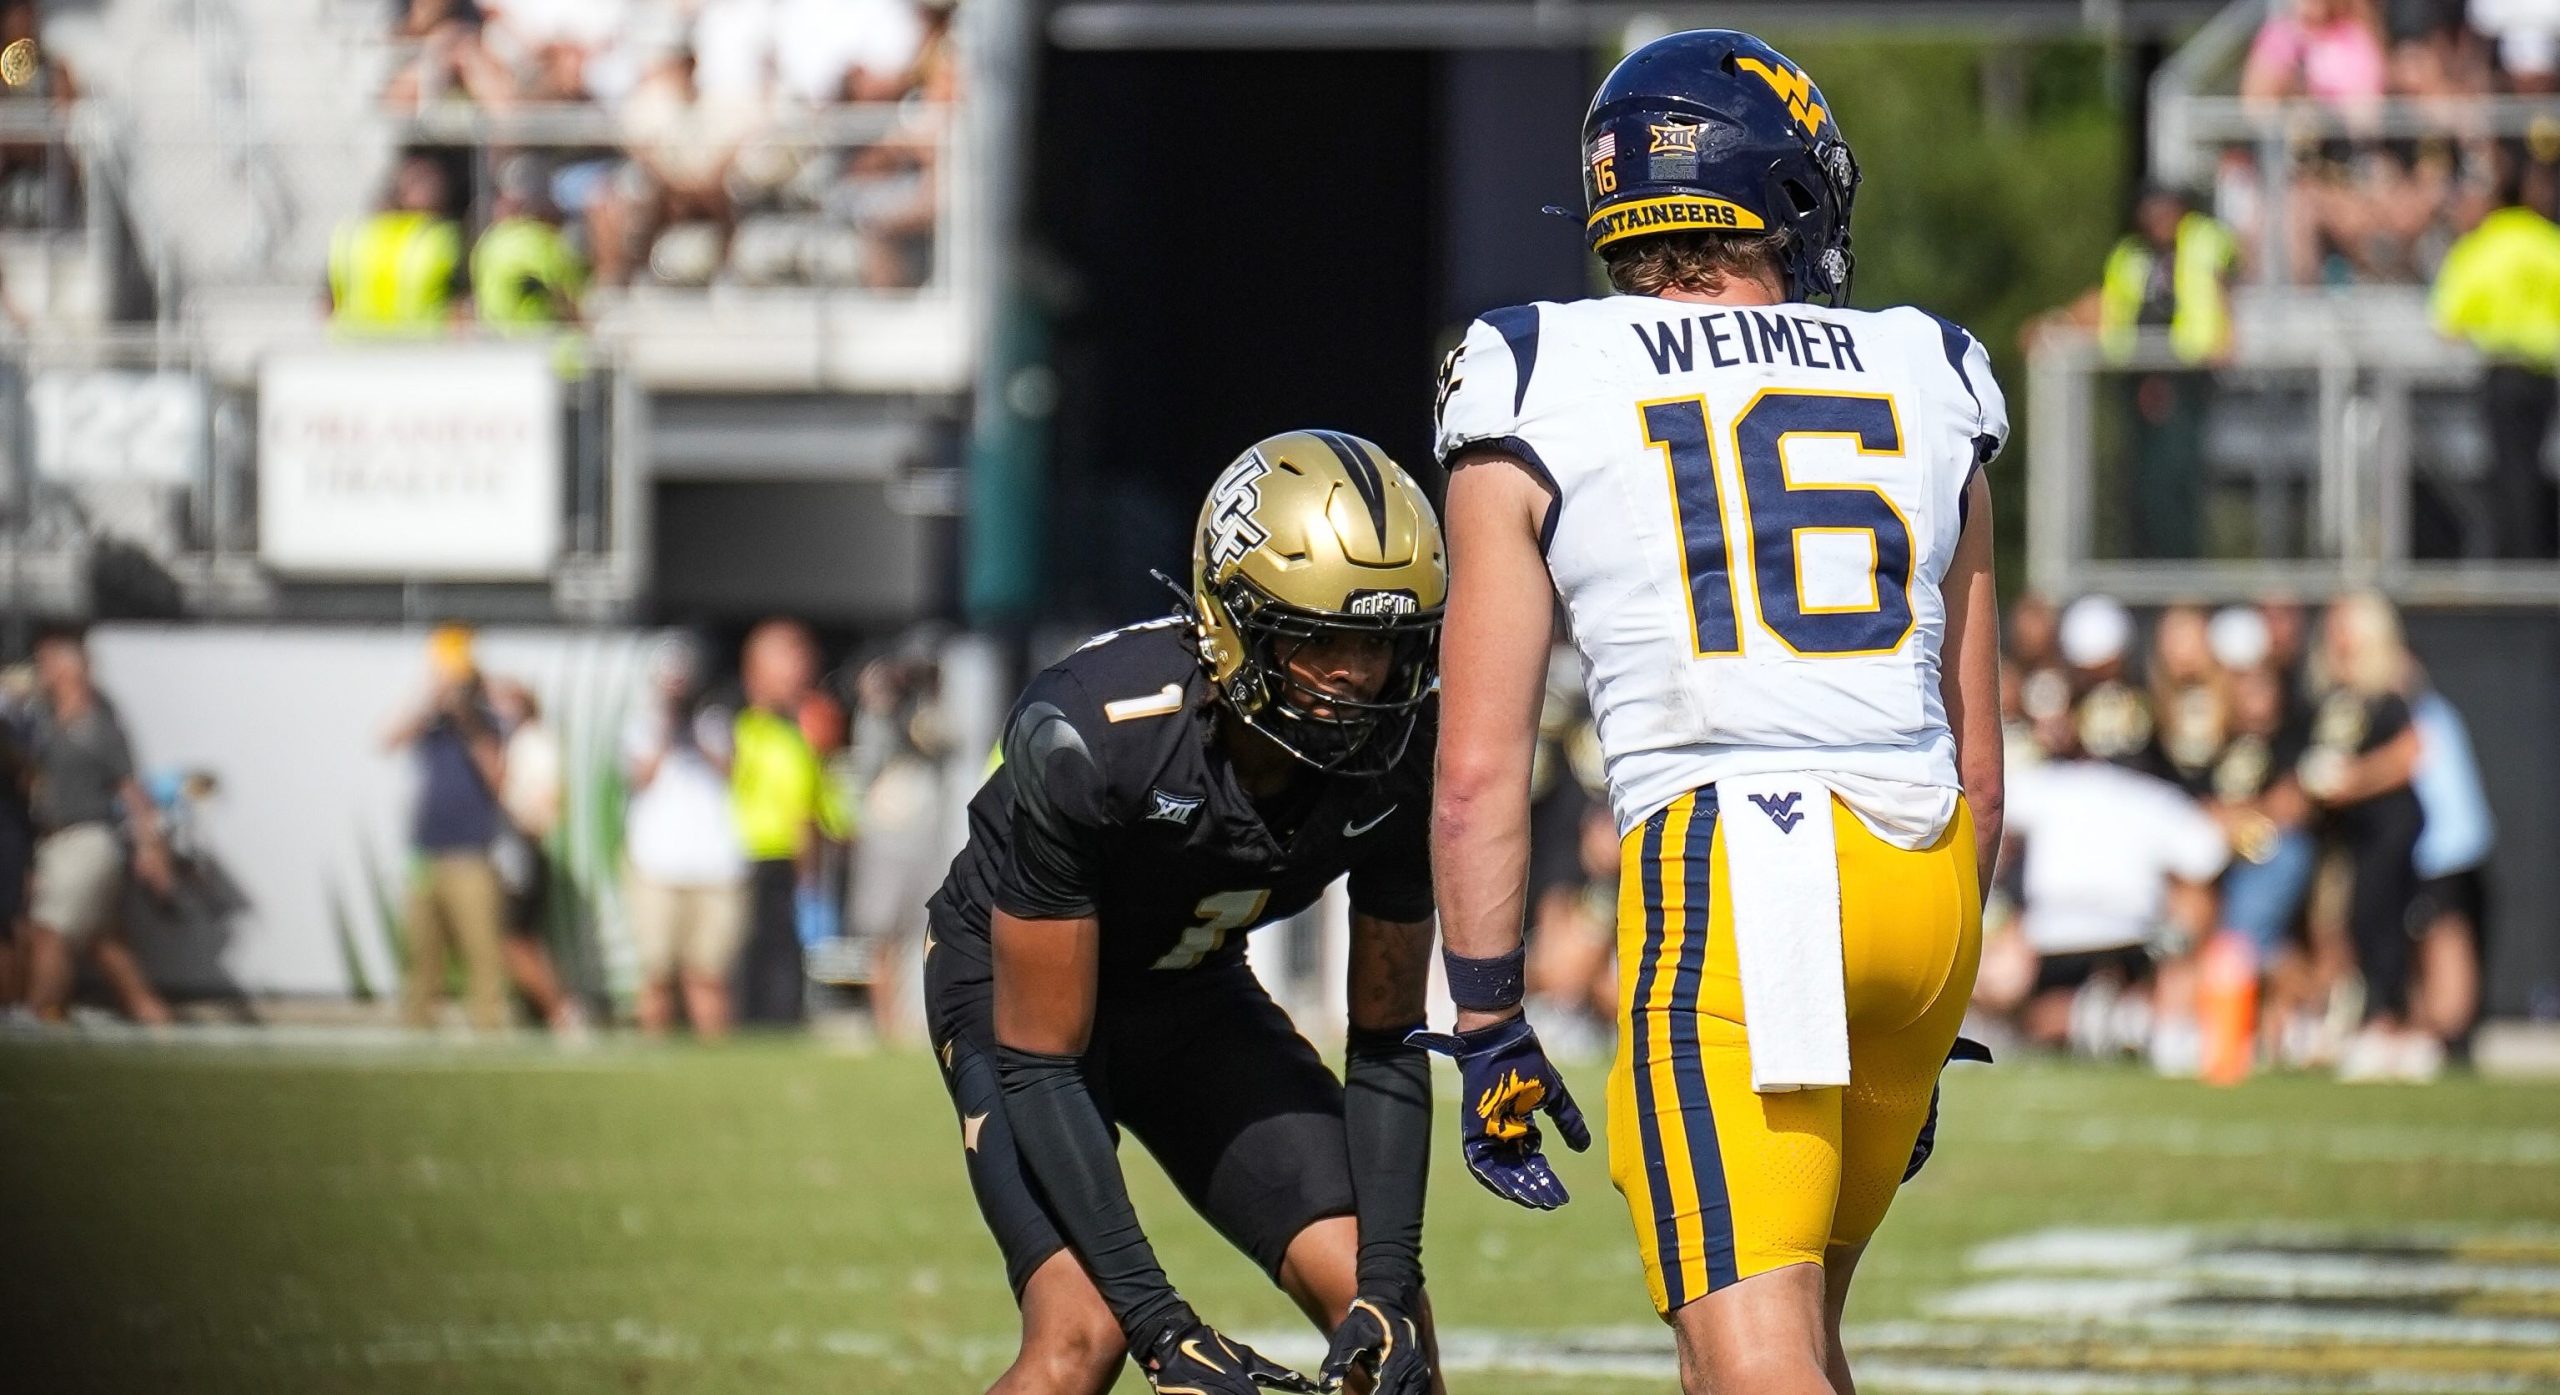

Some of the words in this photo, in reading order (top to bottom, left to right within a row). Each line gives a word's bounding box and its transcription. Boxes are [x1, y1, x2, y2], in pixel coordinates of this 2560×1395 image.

[1594, 158, 1617, 196] 16
[1632, 311, 1864, 375] WEIMER
[1210, 448, 1272, 573] UCF
[1636, 387, 1917, 659] 16
[1104, 683, 1183, 723] 1
[1150, 888, 1271, 970] 1
